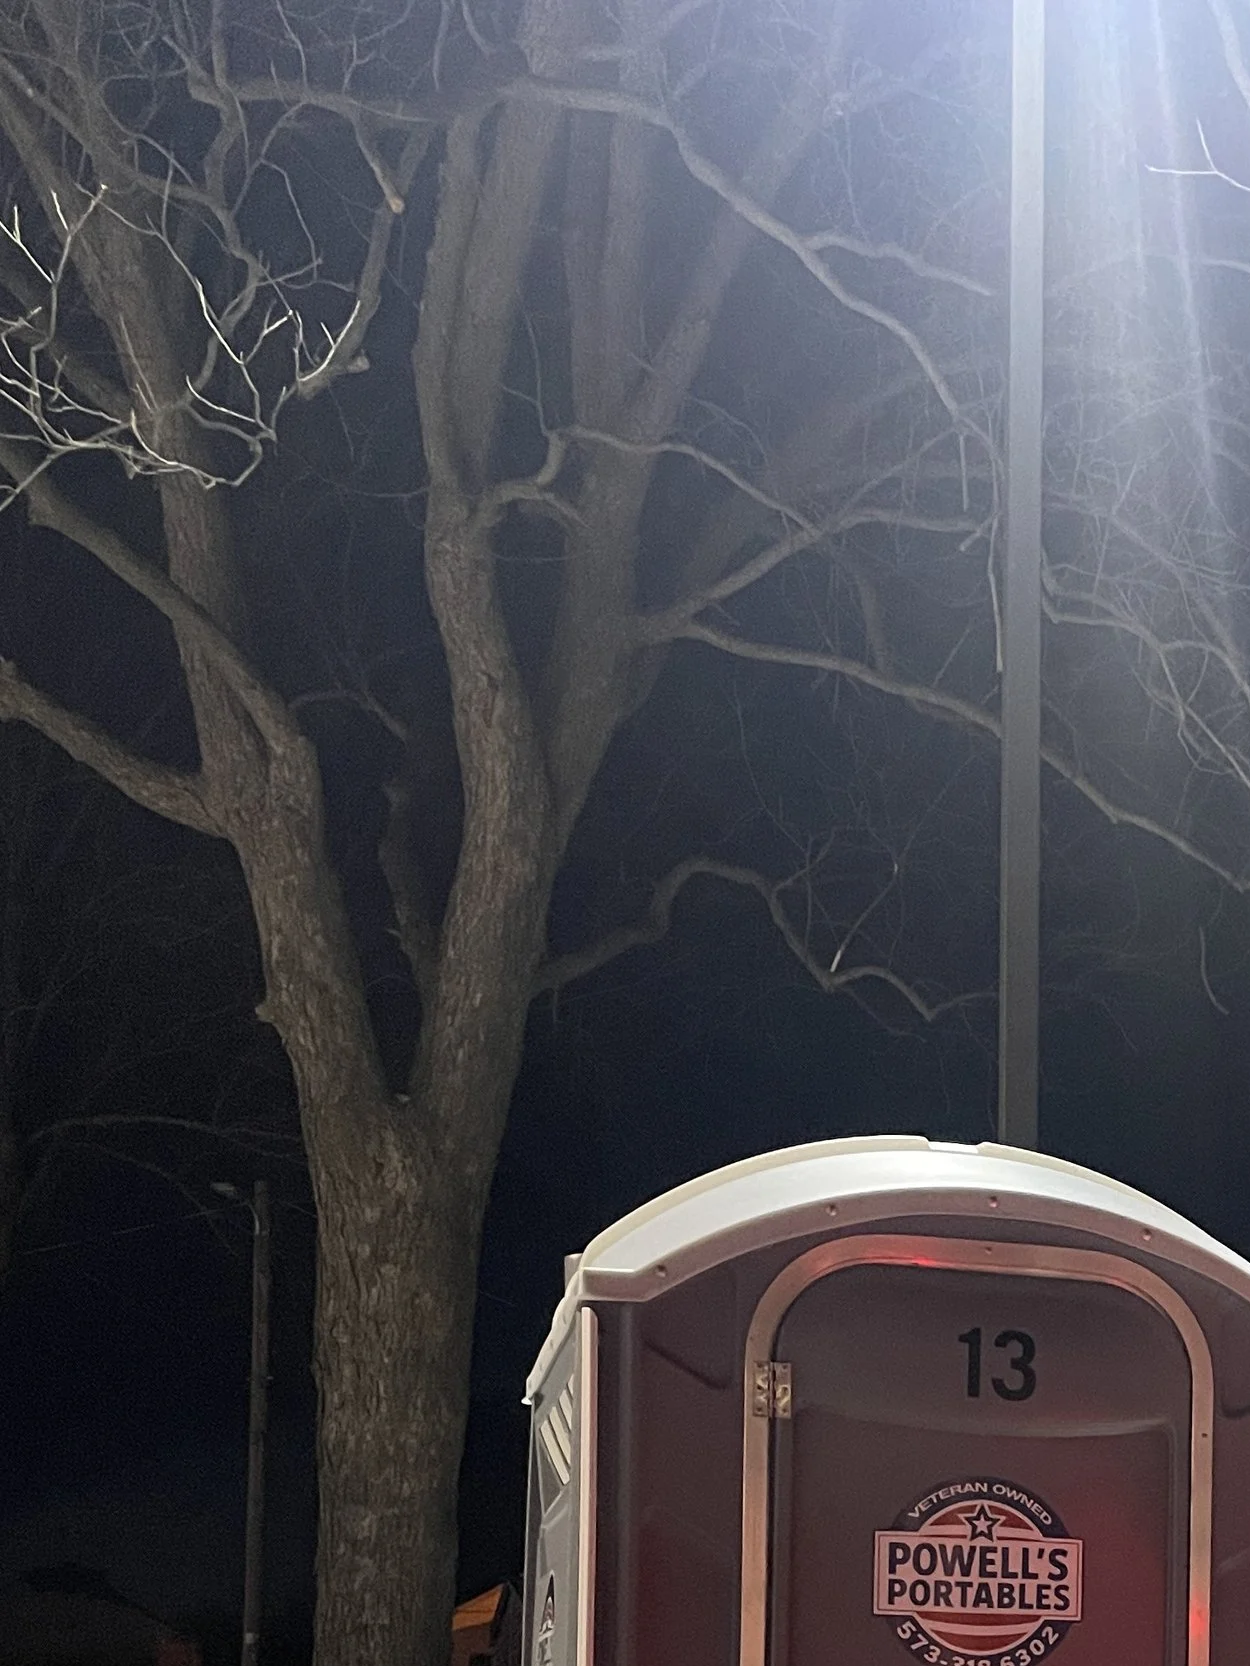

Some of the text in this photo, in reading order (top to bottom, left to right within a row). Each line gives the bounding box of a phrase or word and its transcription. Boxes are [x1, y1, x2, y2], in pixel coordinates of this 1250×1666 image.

[958, 1328, 1037, 1401] 13
[908, 1482, 1053, 1526] VETERAN OWNED
[887, 1541, 1069, 1581] POWELL'S
[887, 1579, 1070, 1612] PORTABLES
